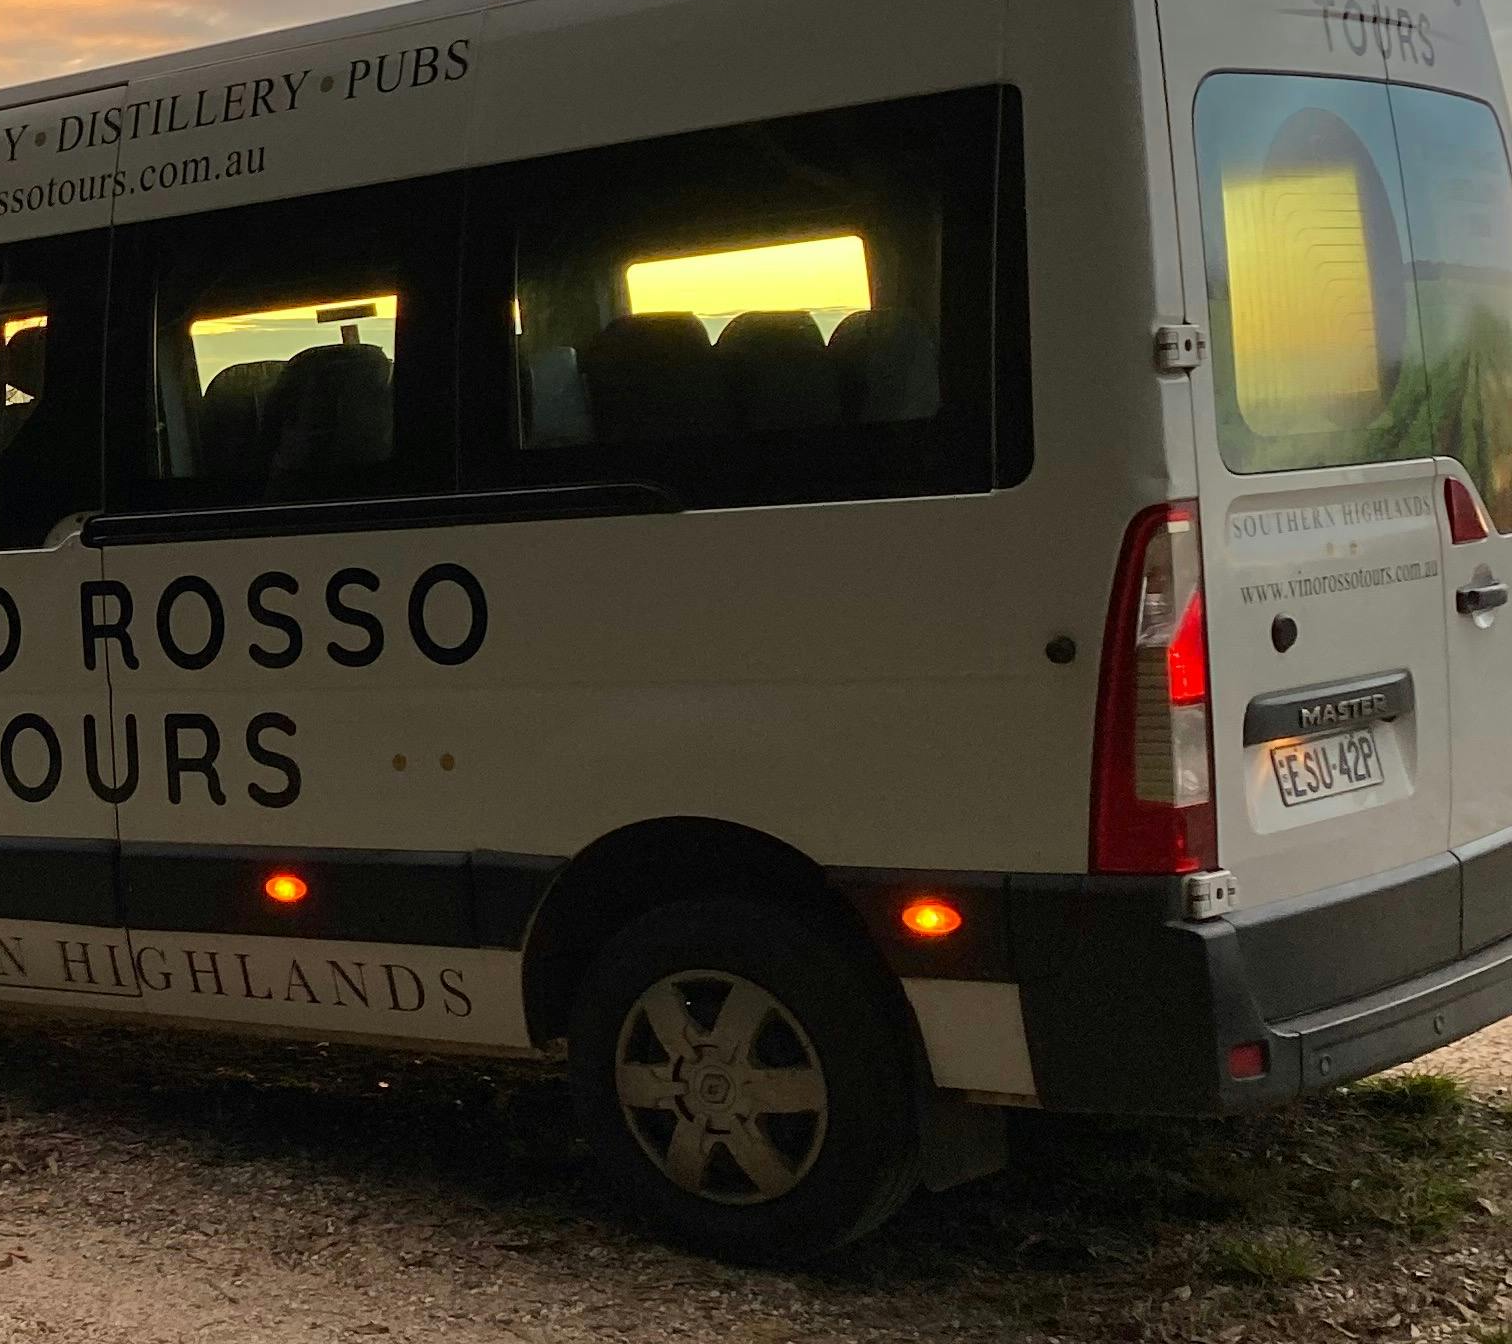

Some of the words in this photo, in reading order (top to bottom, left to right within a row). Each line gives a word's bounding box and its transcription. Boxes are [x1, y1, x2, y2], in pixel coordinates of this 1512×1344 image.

[56, 70, 310, 153] DISTILLERY
[343, 39, 472, 100] PUBS
[1233, 504, 1336, 539] SOUTHERN
[1342, 495, 1431, 525] HIGHLANDS
[1240, 559, 1438, 605] www.vinorossotours.com.au
[80, 563, 489, 671] ROSSO
[1299, 693, 1386, 728] MASTER
[59, 939, 474, 1017] HIGHLANDS
